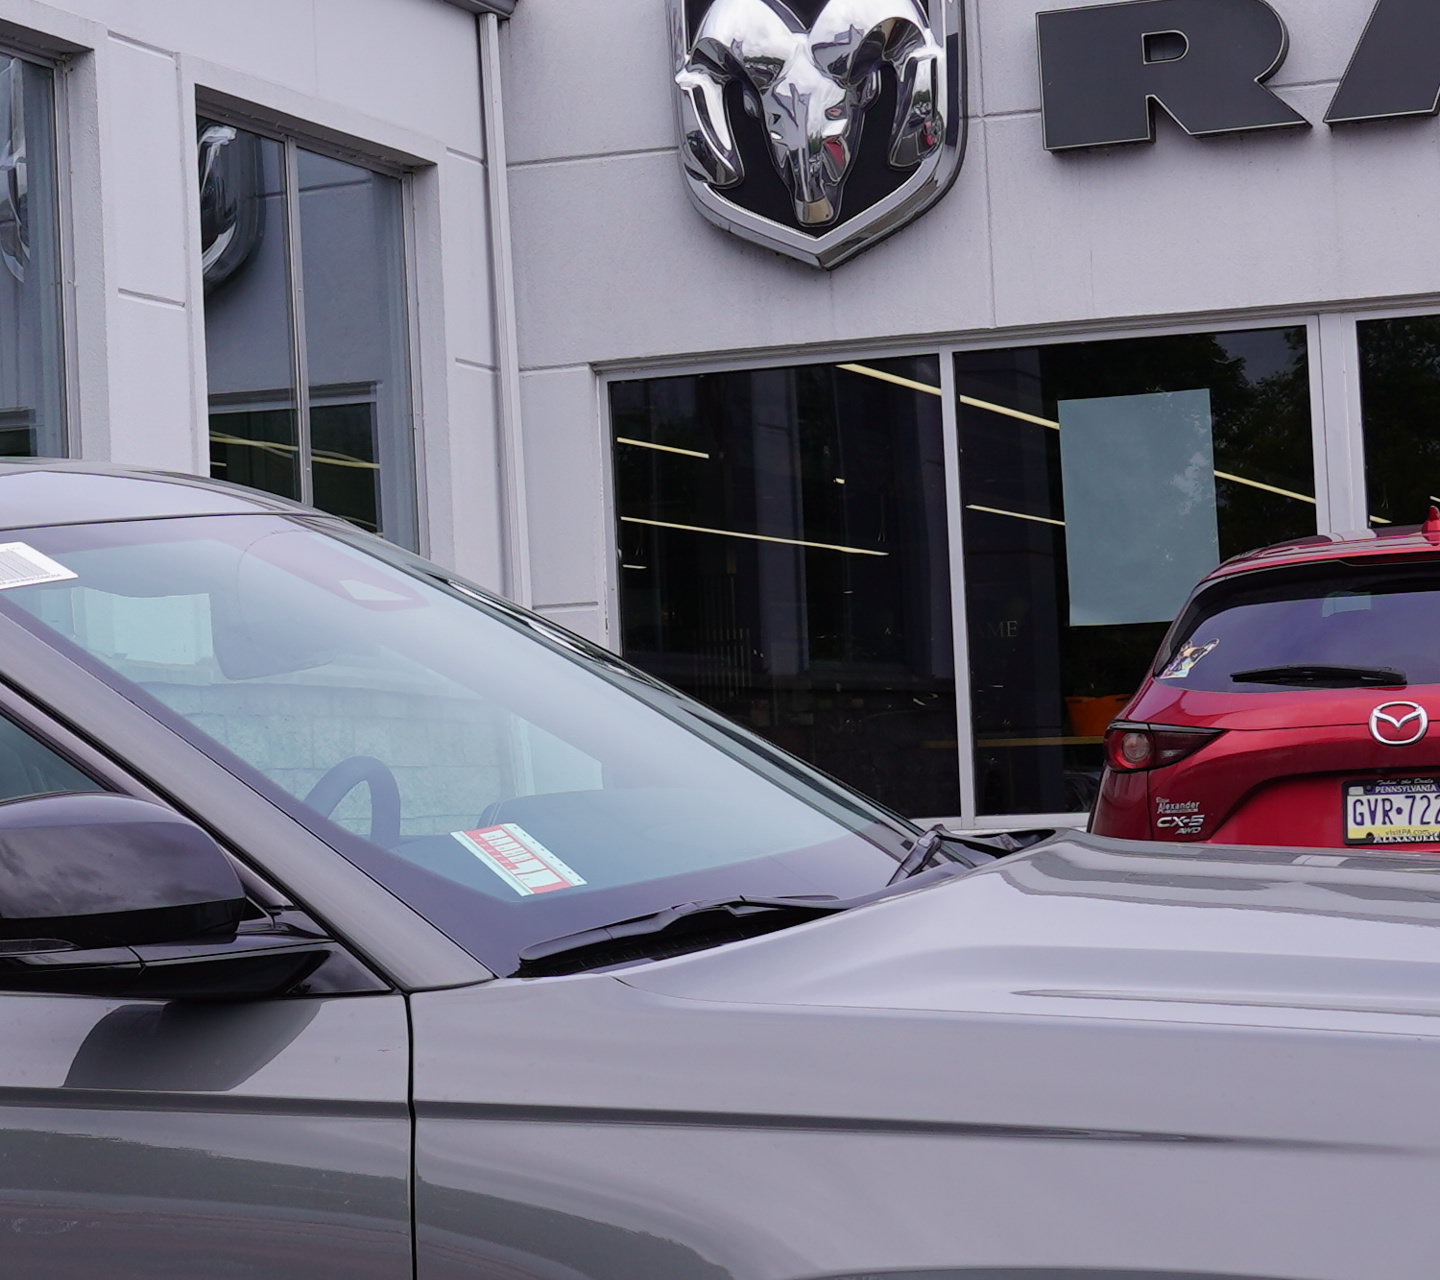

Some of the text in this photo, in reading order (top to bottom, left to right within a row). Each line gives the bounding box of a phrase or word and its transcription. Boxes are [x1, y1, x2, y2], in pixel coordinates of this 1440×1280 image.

[1375, 784, 1437, 794] PENNSYLVANIA
[1156, 814, 1205, 827] CX-5
[1175, 826, 1201, 835] AWD
